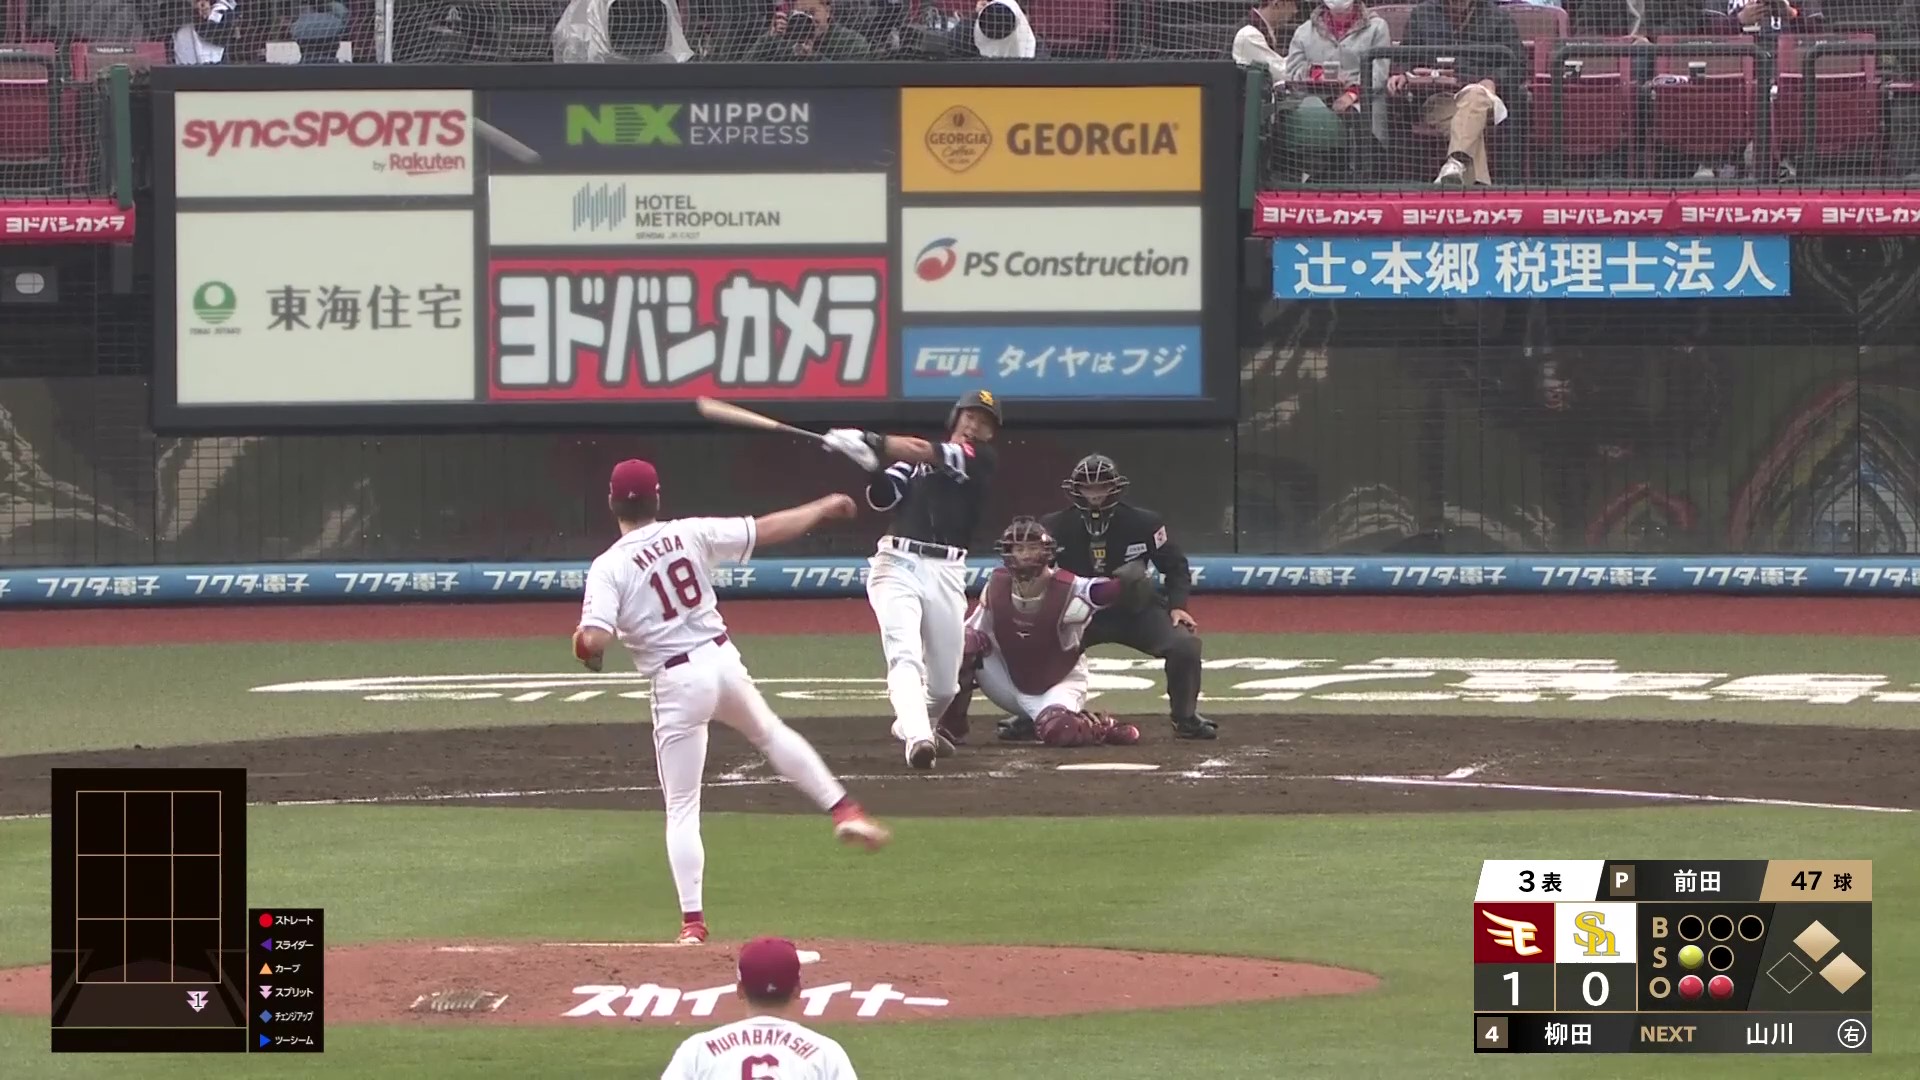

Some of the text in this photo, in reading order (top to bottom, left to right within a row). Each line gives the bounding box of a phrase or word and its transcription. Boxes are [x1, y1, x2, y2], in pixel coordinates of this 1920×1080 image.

[690, 103, 809, 123] NIPPON
[182, 109, 467, 156] syncSPORTS
[690, 126, 809, 144] EXPRESS
[929, 133, 988, 144] GEORGIA
[1006, 122, 1178, 156] GEORGIA
[389, 152, 465, 175] Rakuten
[635, 195, 696, 210] HOTEL
[6, 215, 126, 233] ヨドバシカメラ
[635, 212, 780, 227] METROPOLITAN
[1263, 206, 1383, 225] ヨドバシカメラ
[1402, 208, 1523, 225] ヨドバシカメラ
[1543, 208, 1663, 225] ヨドバシカメラ
[1682, 206, 1802, 224] ヨドバシカメラ
[963, 248, 1189, 277] PS Construction
[1294, 240, 1776, 295] 辻・本郷 税理士法人
[266, 284, 462, 331] 東海住宅
[496, 272, 880, 387] ヨドバシカメラ
[998, 345, 1187, 377] タイヤはフジ
[632, 535, 684, 571] MAEDA
[37, 576, 160, 598] フクダ電子
[186, 573, 309, 594] フクダ電子
[335, 572, 459, 593] フクダ電子
[1232, 566, 1355, 588] フクダ電子
[1382, 566, 1506, 587] フクダ電子
[1532, 566, 1656, 587] フクダ電子
[1682, 566, 1808, 587] フクダ電子
[649, 556, 702, 621] 18
[561, 982, 949, 1017] スカイイナー
[705, 1028, 820, 1060] MURABAYASHI
